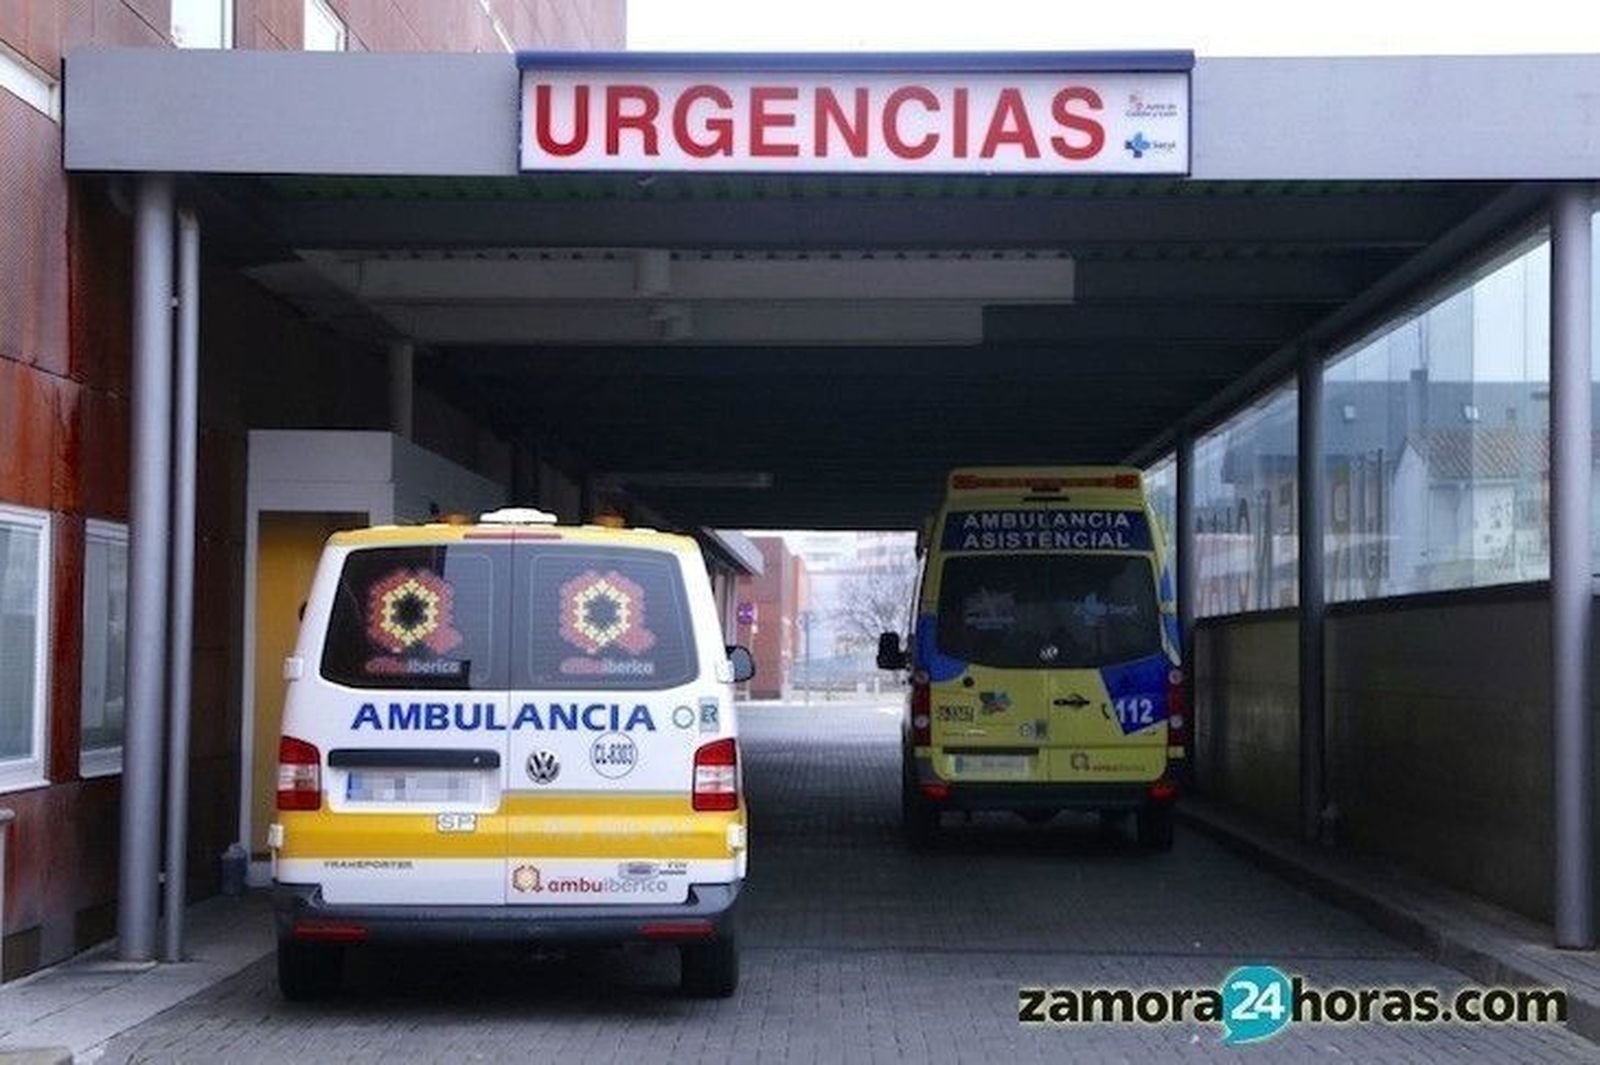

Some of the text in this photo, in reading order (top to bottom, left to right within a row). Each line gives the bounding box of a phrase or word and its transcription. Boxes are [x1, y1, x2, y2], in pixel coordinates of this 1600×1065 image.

[535, 84, 1106, 160] URGENCIAS
[964, 513, 1130, 528] AMBULANCIA
[964, 532, 1130, 549] ASISTENCIAL
[351, 703, 656, 731] AMBULANCIA
[1115, 699, 1155, 724] 112
[441, 815, 472, 829] SP
